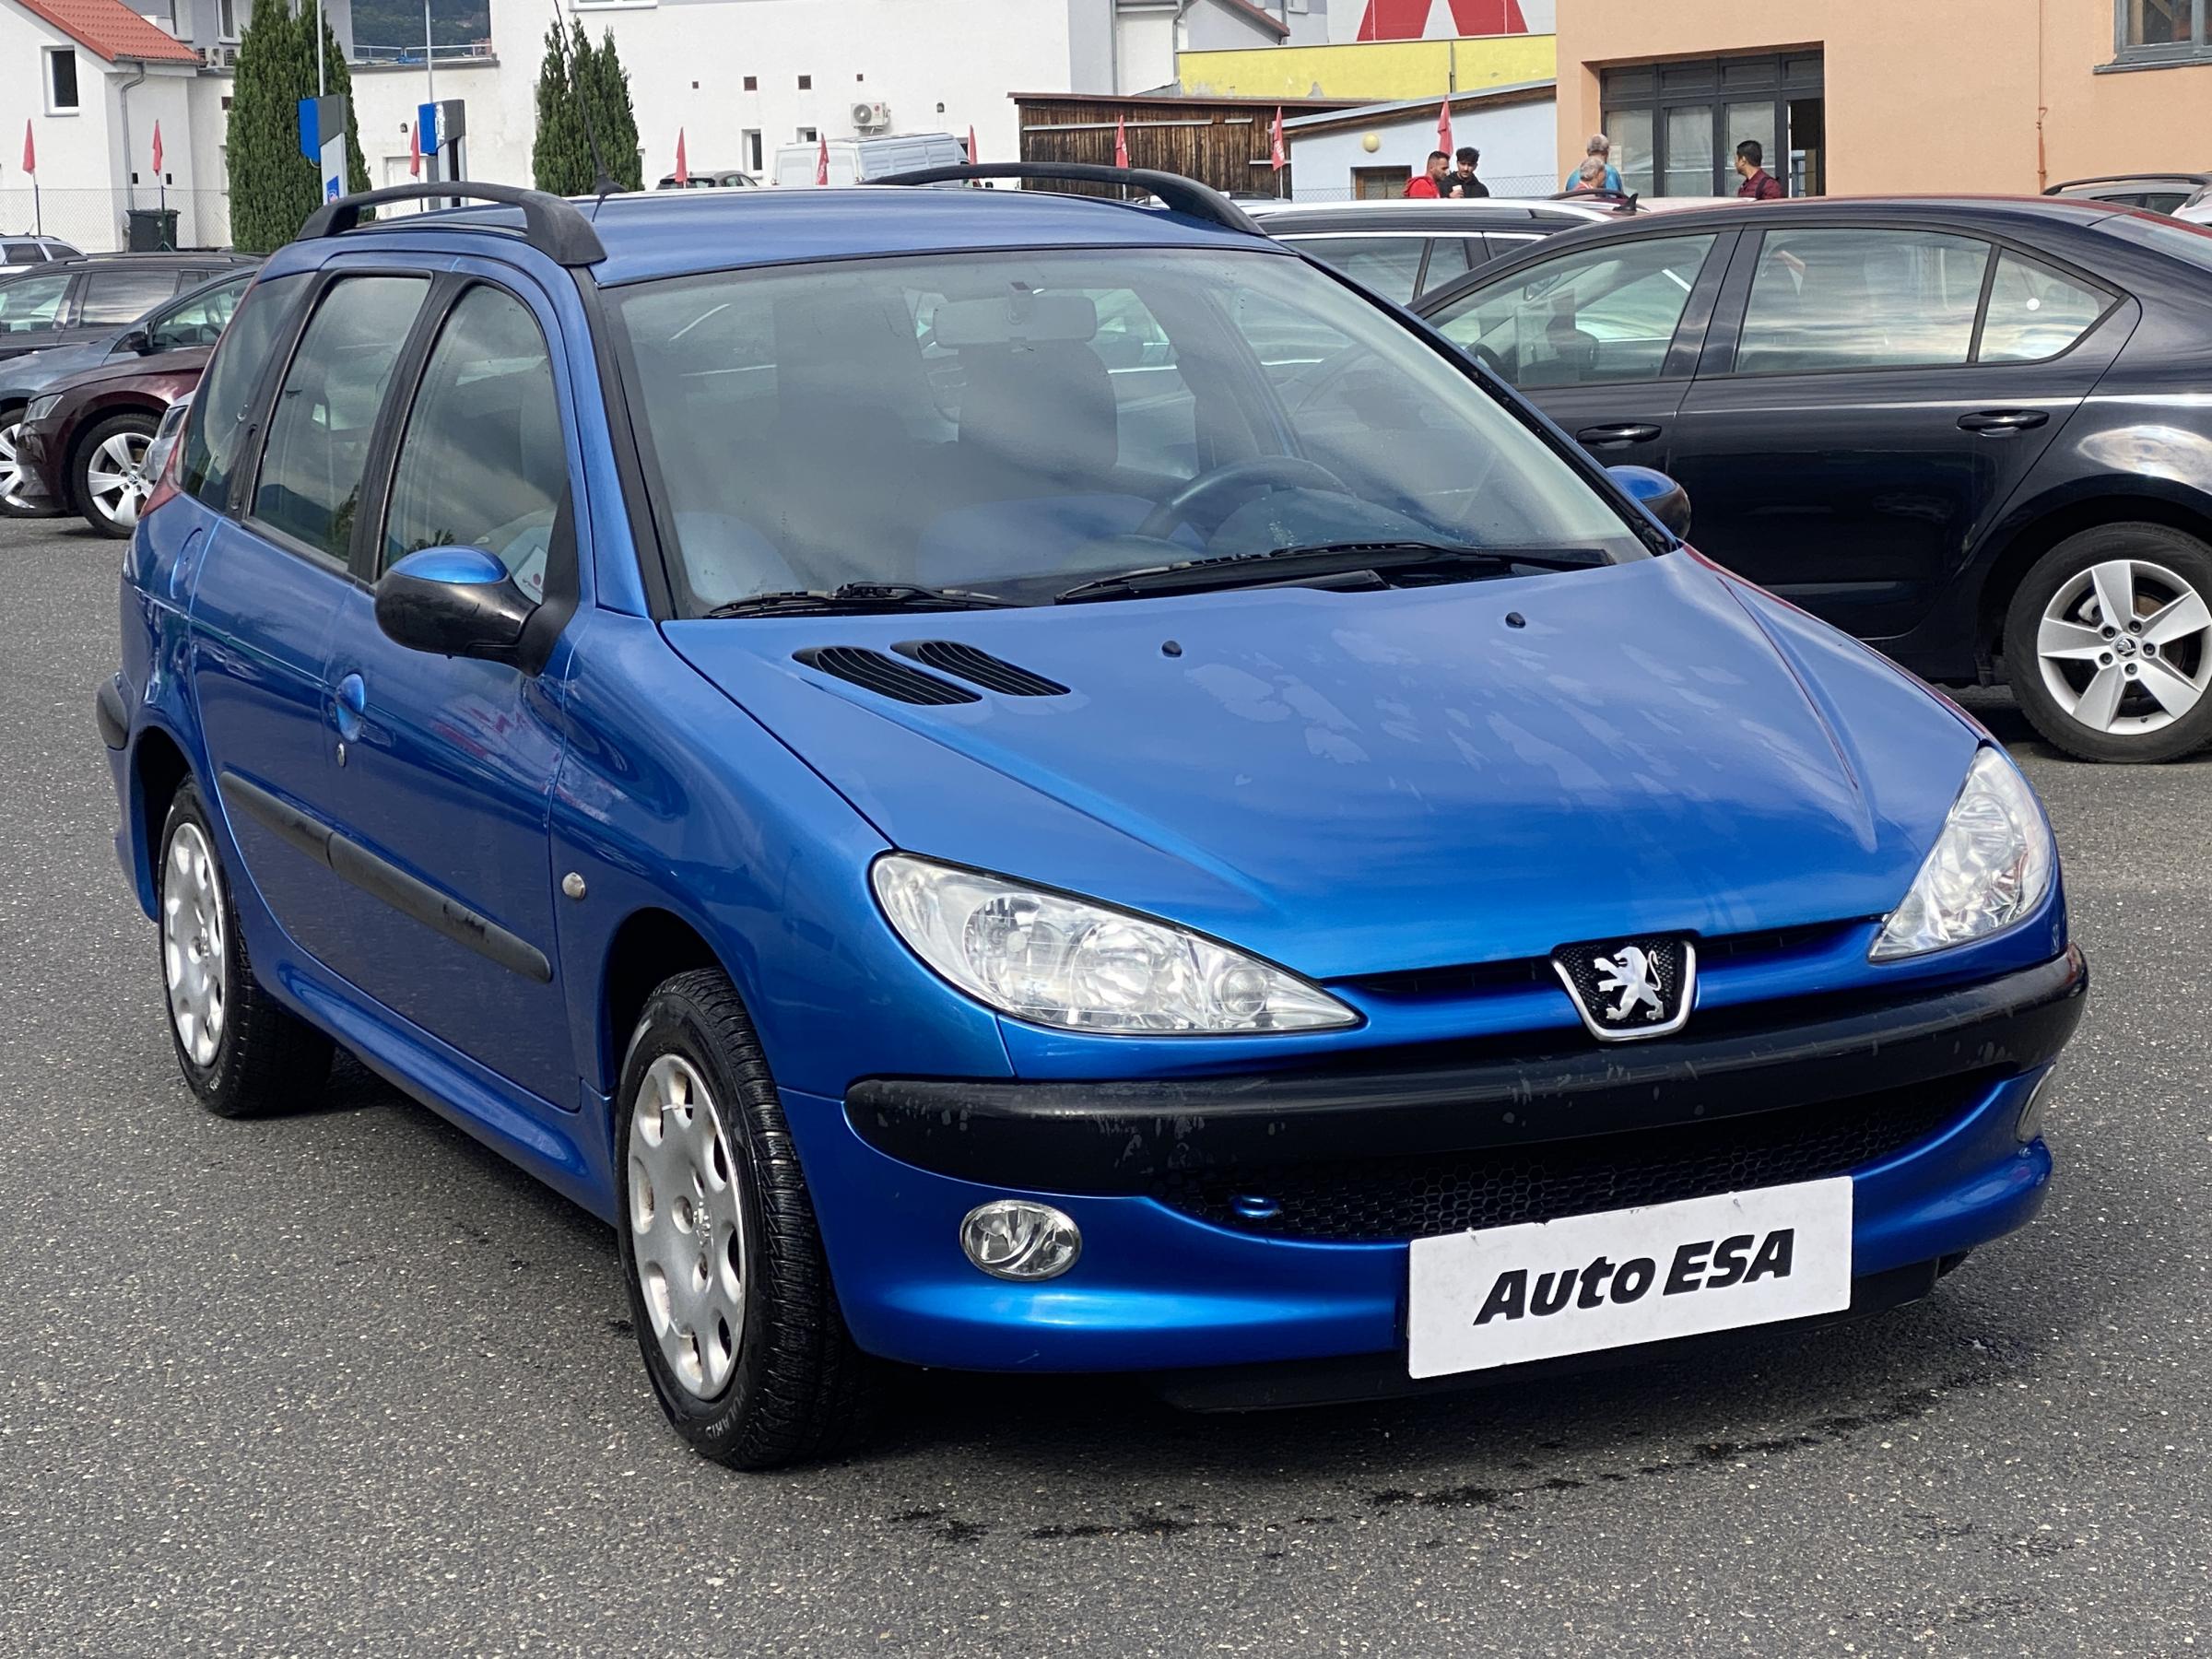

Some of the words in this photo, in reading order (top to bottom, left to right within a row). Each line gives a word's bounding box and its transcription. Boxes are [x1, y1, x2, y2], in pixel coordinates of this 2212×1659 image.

[1473, 1255, 1656, 1326] Auto
[1662, 1228, 1794, 1296] ESA
[705, 1383, 747, 1440] POLARIS
